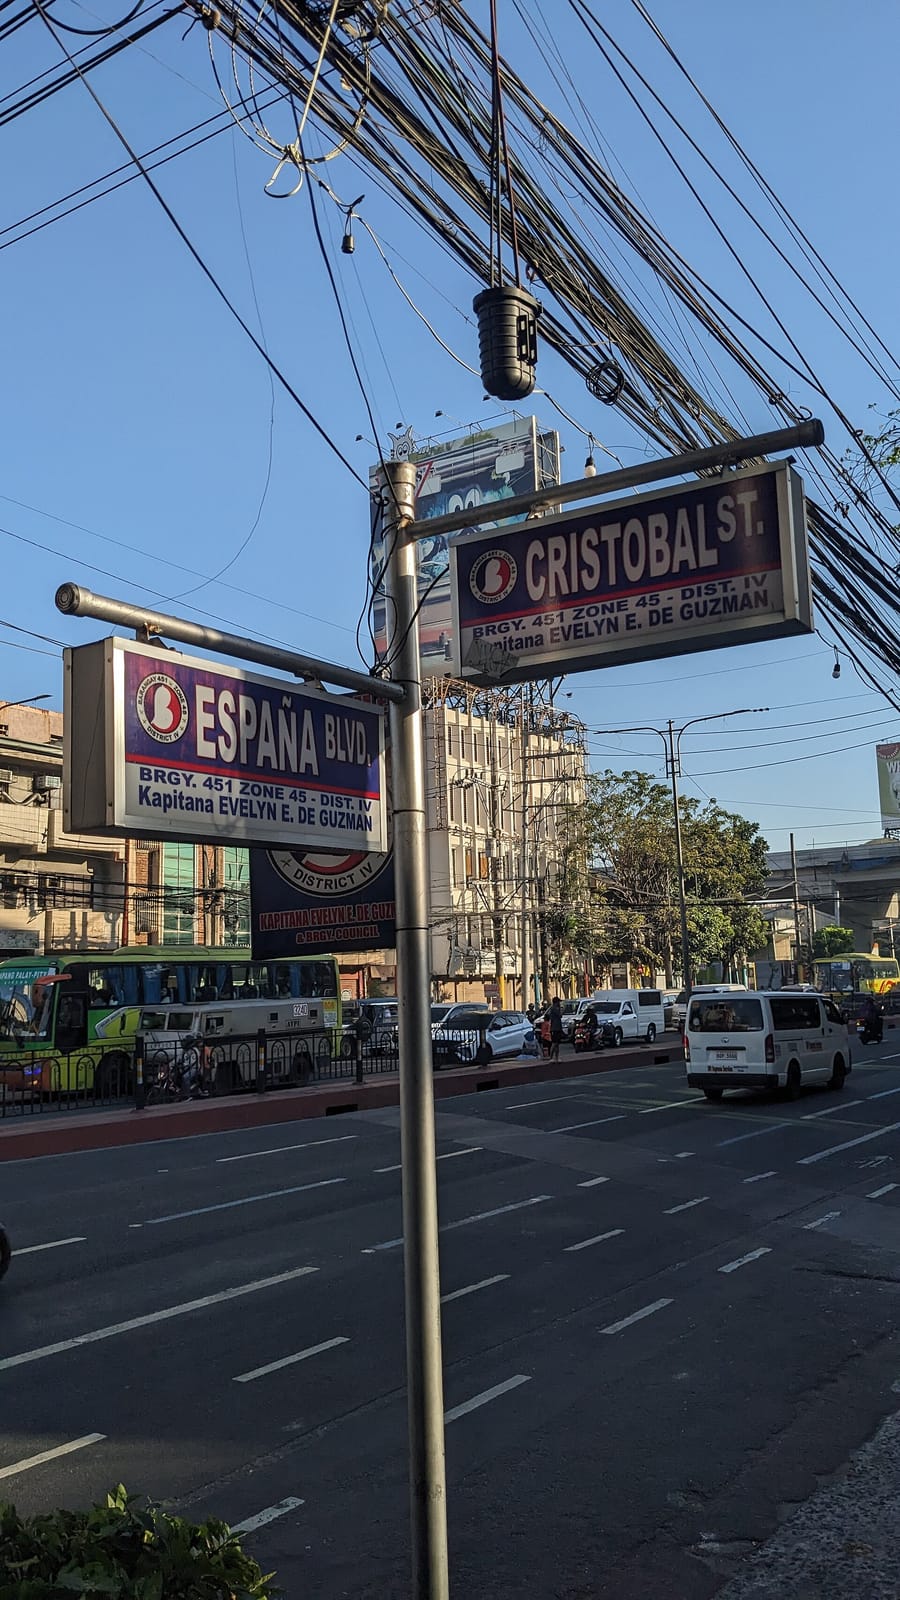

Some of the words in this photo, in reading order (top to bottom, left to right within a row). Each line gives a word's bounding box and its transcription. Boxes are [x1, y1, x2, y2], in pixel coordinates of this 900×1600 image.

[526, 504, 719, 602] CRISTOBAL
[716, 490, 764, 543] ST.
[472, 618, 526, 640] BRGY.
[532, 611, 565, 628] 451
[572, 600, 629, 621] ZONE
[636, 593, 660, 610] 45
[681, 582, 736, 602] DIST.
[744, 574, 767, 590] IV
[549, 616, 619, 644] EVELYN
[625, 614, 642, 631] E.
[648, 607, 673, 627] DE
[680, 589, 769, 621] GUZMAN
[147, 726, 172, 741] DISTRICT
[195, 684, 320, 776] ESPAÑA
[324, 713, 371, 767] BLVD.
[138, 785, 214, 815] Kapitana
[219, 796, 277, 821] EVELYN
[281, 804, 294, 823] E.
[298, 806, 316, 826] DE
[319, 809, 372, 832] GUZMAN
[139, 767, 197, 788] BRGY.
[203, 777, 233, 793] 451
[239, 782, 284, 800] ZONE
[289, 788, 307, 803] 45
[320, 793, 354, 810] DIST.
[358, 798, 372, 812] IV
[294, 868, 356, 890] DISTRICT
[359, 862, 373, 878] IV
[259, 908, 310, 931] KAPITANA
[310, 905, 346, 926] EVELYN
[346, 905, 356, 922] E.
[356, 903, 372, 921] DE
[335, 925, 380, 941] COUNCIL
